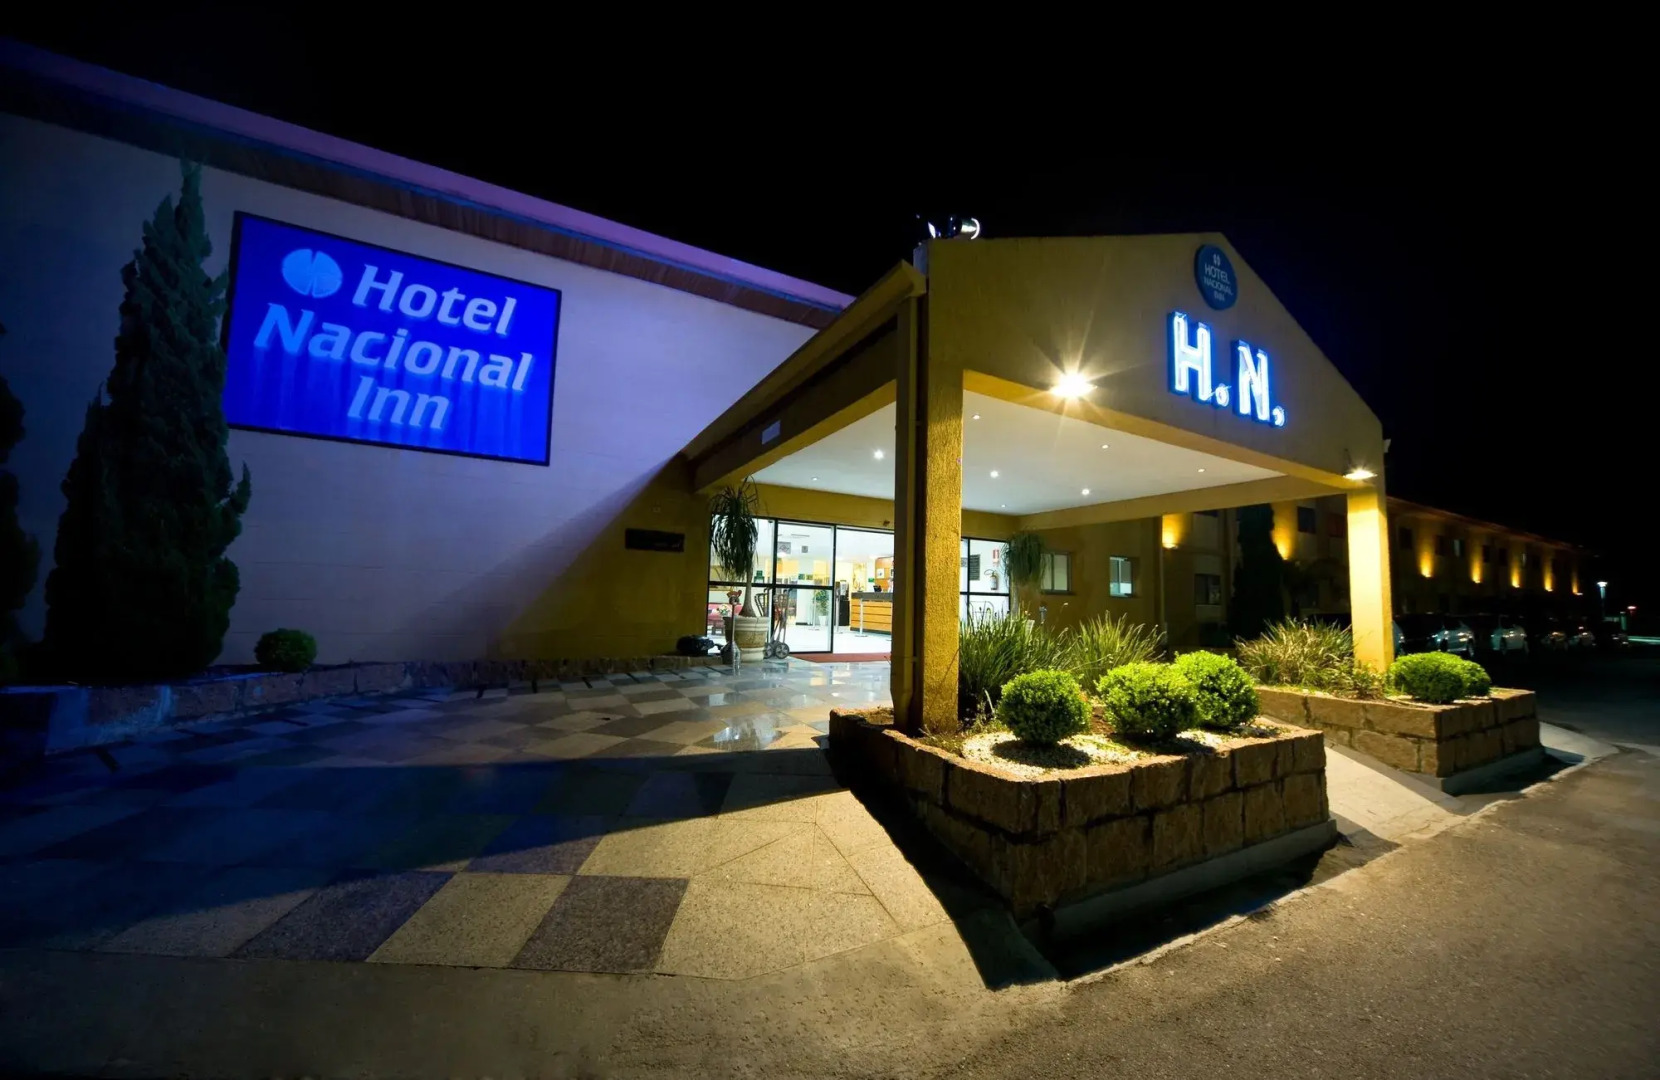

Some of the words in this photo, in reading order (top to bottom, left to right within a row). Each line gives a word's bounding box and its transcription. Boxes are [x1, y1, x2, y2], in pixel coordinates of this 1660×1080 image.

[352, 264, 517, 336] Hotel
[1204, 263, 1230, 284] HOTEL
[254, 303, 533, 391] Nacional
[347, 376, 450, 430] Inn
